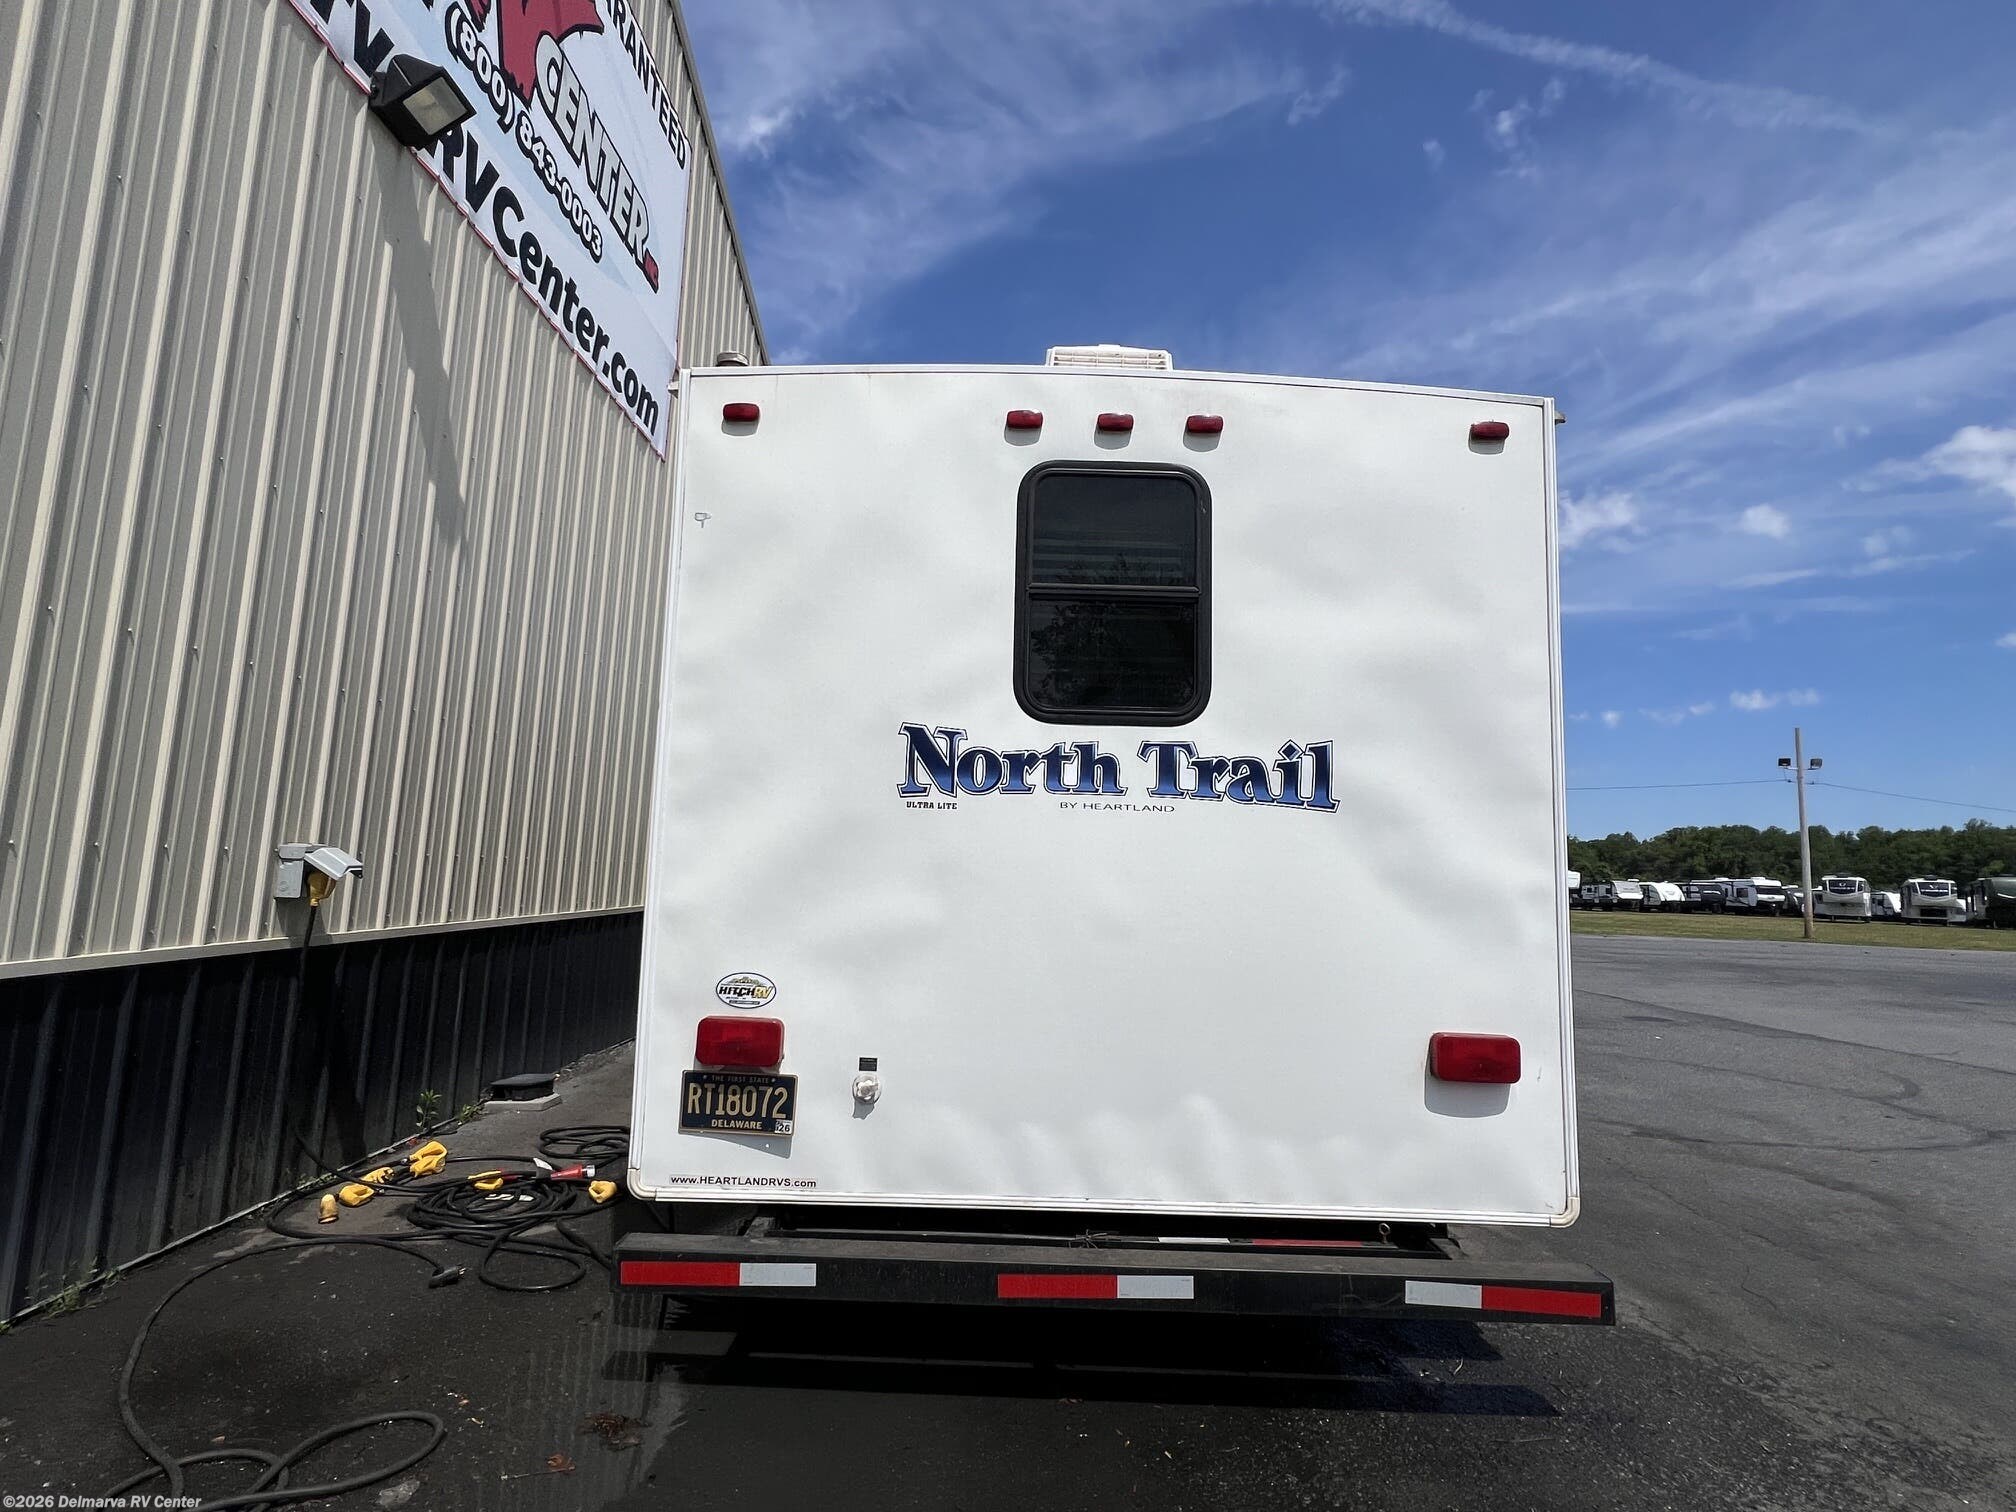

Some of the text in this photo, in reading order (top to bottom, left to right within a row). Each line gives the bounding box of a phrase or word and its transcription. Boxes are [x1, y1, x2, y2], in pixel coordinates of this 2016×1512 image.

[606, 0, 687, 170] RANTEED
[444, 1, 516, 134] (800)
[515, 110, 604, 264] 843-0003
[536, 30, 651, 268] CENTER
[897, 721, 1341, 813] North Trail
[905, 801, 958, 810] ULTRA LITE
[1060, 802, 1175, 813] BY HEARTLAND
[687, 1082, 788, 1119] RT18072
[711, 1119, 763, 1130] DELAWARE
[778, 1123, 791, 1133] 26
[670, 1176, 817, 1188] www.HEARTLANDRVS.com
